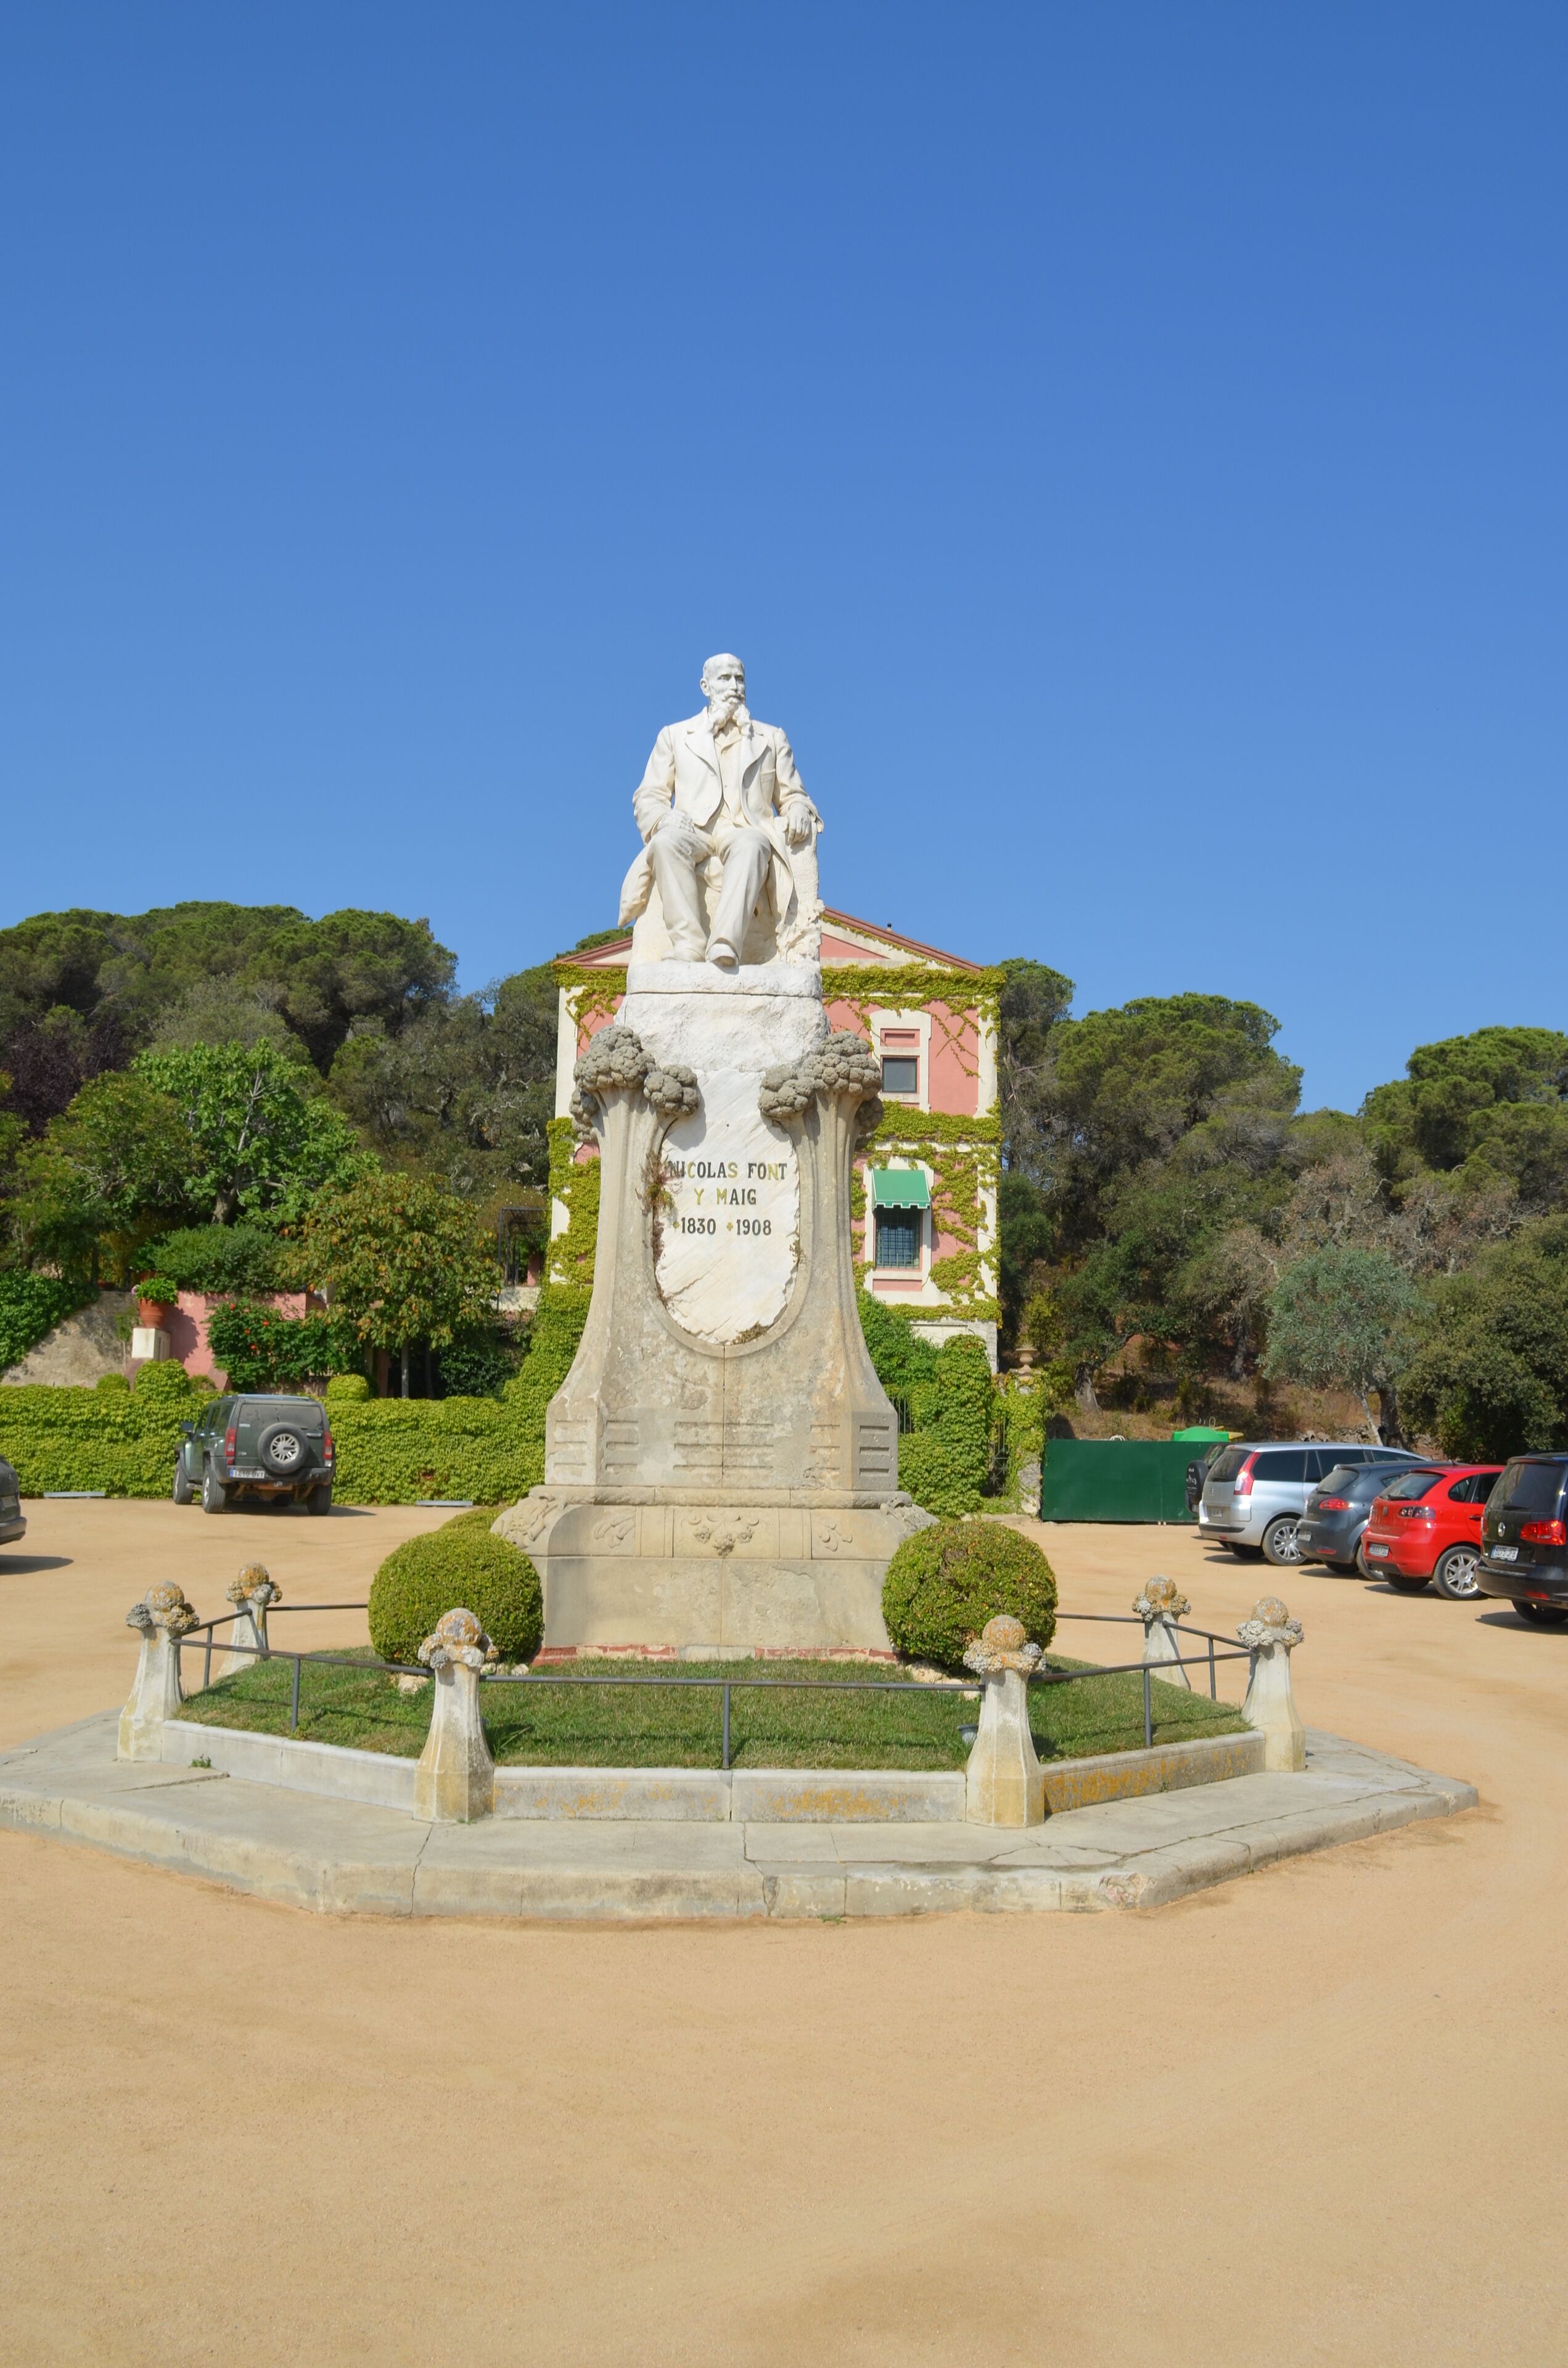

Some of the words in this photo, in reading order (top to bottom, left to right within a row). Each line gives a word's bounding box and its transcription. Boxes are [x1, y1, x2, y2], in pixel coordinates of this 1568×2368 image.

[668, 1160, 738, 1179] NICOLAS
[747, 1162, 787, 1180] FONT
[694, 1188, 704, 1205] Y
[716, 1188, 757, 1205] MAIG
[681, 1217, 716, 1235] 1830
[736, 1219, 771, 1235] 1908
